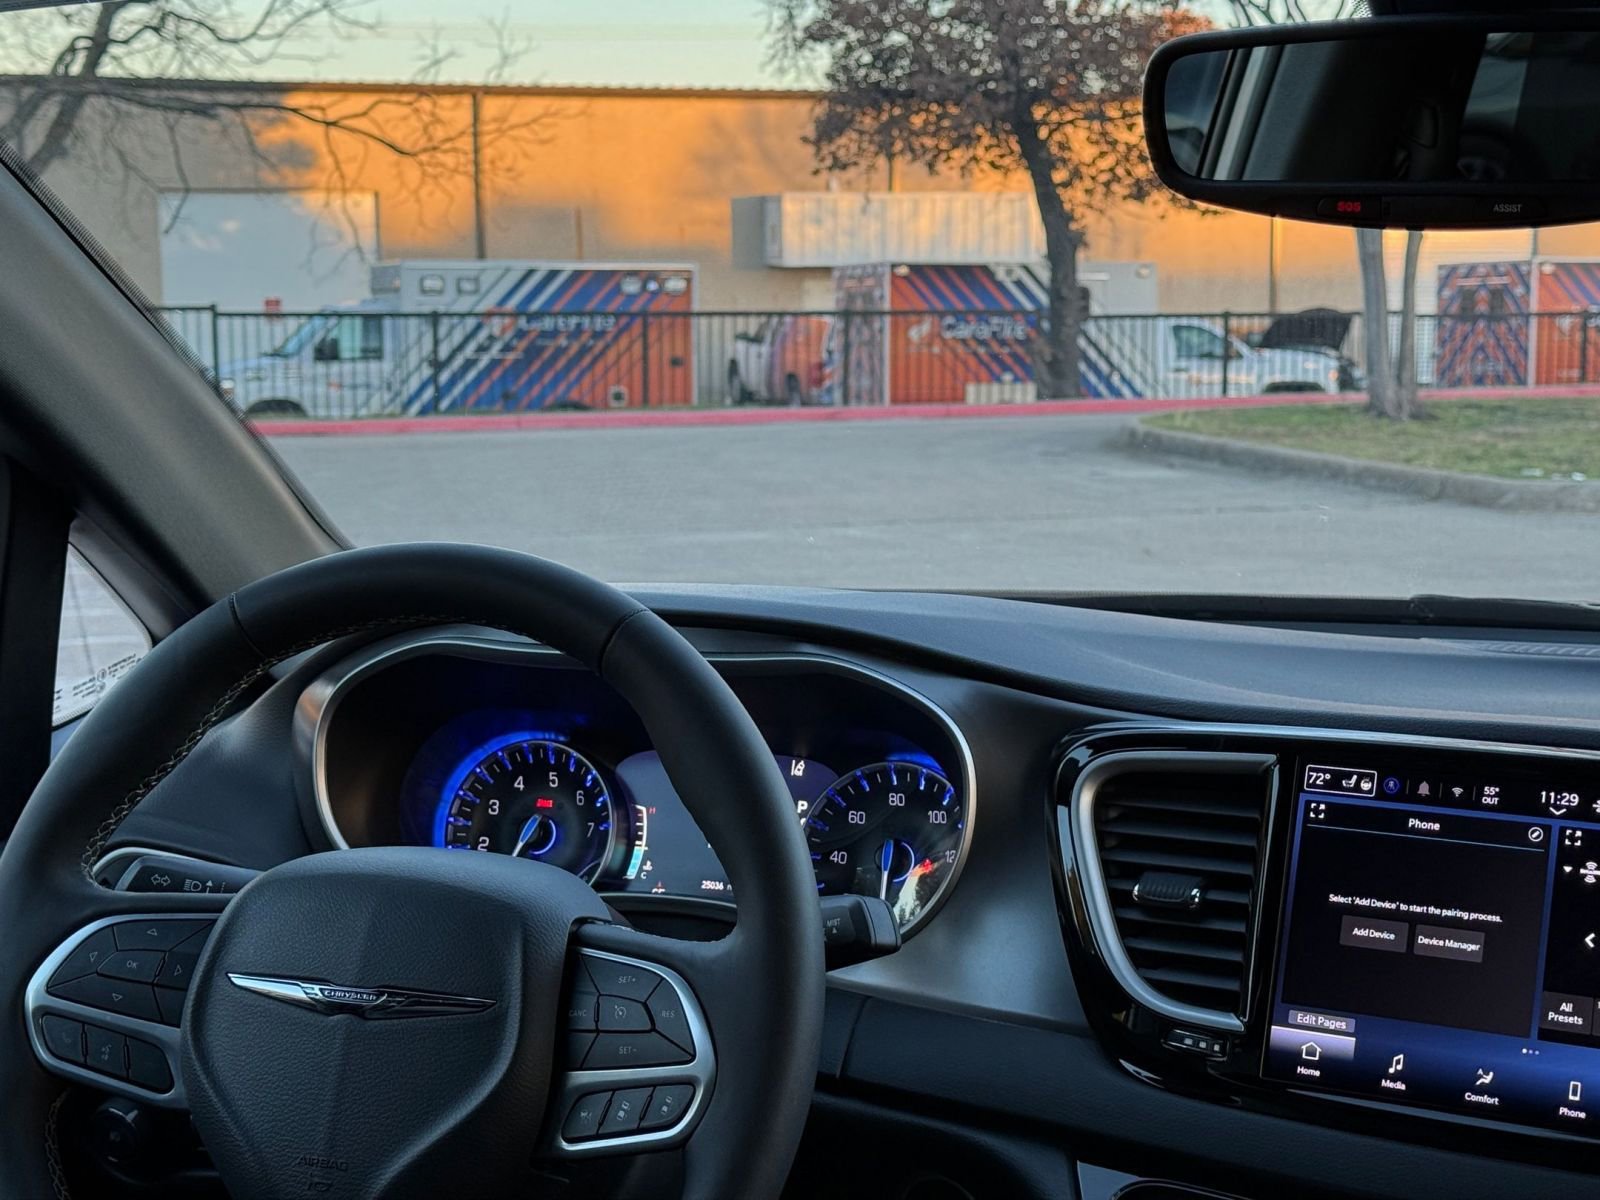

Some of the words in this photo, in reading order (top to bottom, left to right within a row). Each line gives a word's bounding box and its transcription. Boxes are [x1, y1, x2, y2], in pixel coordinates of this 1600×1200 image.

[1336, 201, 1361, 212] SOS
[1492, 203, 1523, 213] ASSIST
[513, 775, 526, 791] 4
[548, 771, 559, 788] 5
[1308, 771, 1332, 785] 72°
[575, 789, 585, 806] 6
[1483, 785, 1500, 796] 55°
[888, 792, 906, 807] 80
[1481, 796, 1500, 805] OUT
[1540, 790, 1580, 806] 11:29
[488, 799, 500, 815] 3
[797, 800, 809, 814] P
[847, 810, 866, 825] 60
[927, 810, 947, 824] 100
[586, 822, 595, 838] 7
[1408, 818, 1441, 831] Phone
[476, 836, 490, 852] 2
[829, 850, 848, 865] 40
[944, 850, 956, 863] 12
[640, 871, 647, 879] C
[701, 880, 724, 891] 25036
[1328, 893, 1352, 904] Select
[1400, 902, 1408, 911] to
[1409, 904, 1427, 914] start
[1428, 906, 1441, 915] the
[1442, 908, 1469, 920] pairing
[1469, 912, 1503, 923] process.
[1352, 927, 1369, 937] Add
[1369, 929, 1396, 940] Device
[1417, 935, 1444, 946] Device
[1445, 939, 1481, 951] Manager
[126, 959, 139, 969] OK
[323, 988, 378, 1001] CHRYSLER
[568, 1009, 588, 1017] CANC
[661, 1009, 676, 1018] RES
[1559, 1002, 1574, 1012] All
[1296, 1013, 1317, 1026] Edit
[1317, 1016, 1347, 1030] Pages
[1548, 1011, 1583, 1025] Presets
[1297, 1065, 1321, 1077] Home
[1381, 1078, 1406, 1091] Media
[1464, 1091, 1500, 1106] Comfort
[1559, 1106, 1587, 1120] Phone
